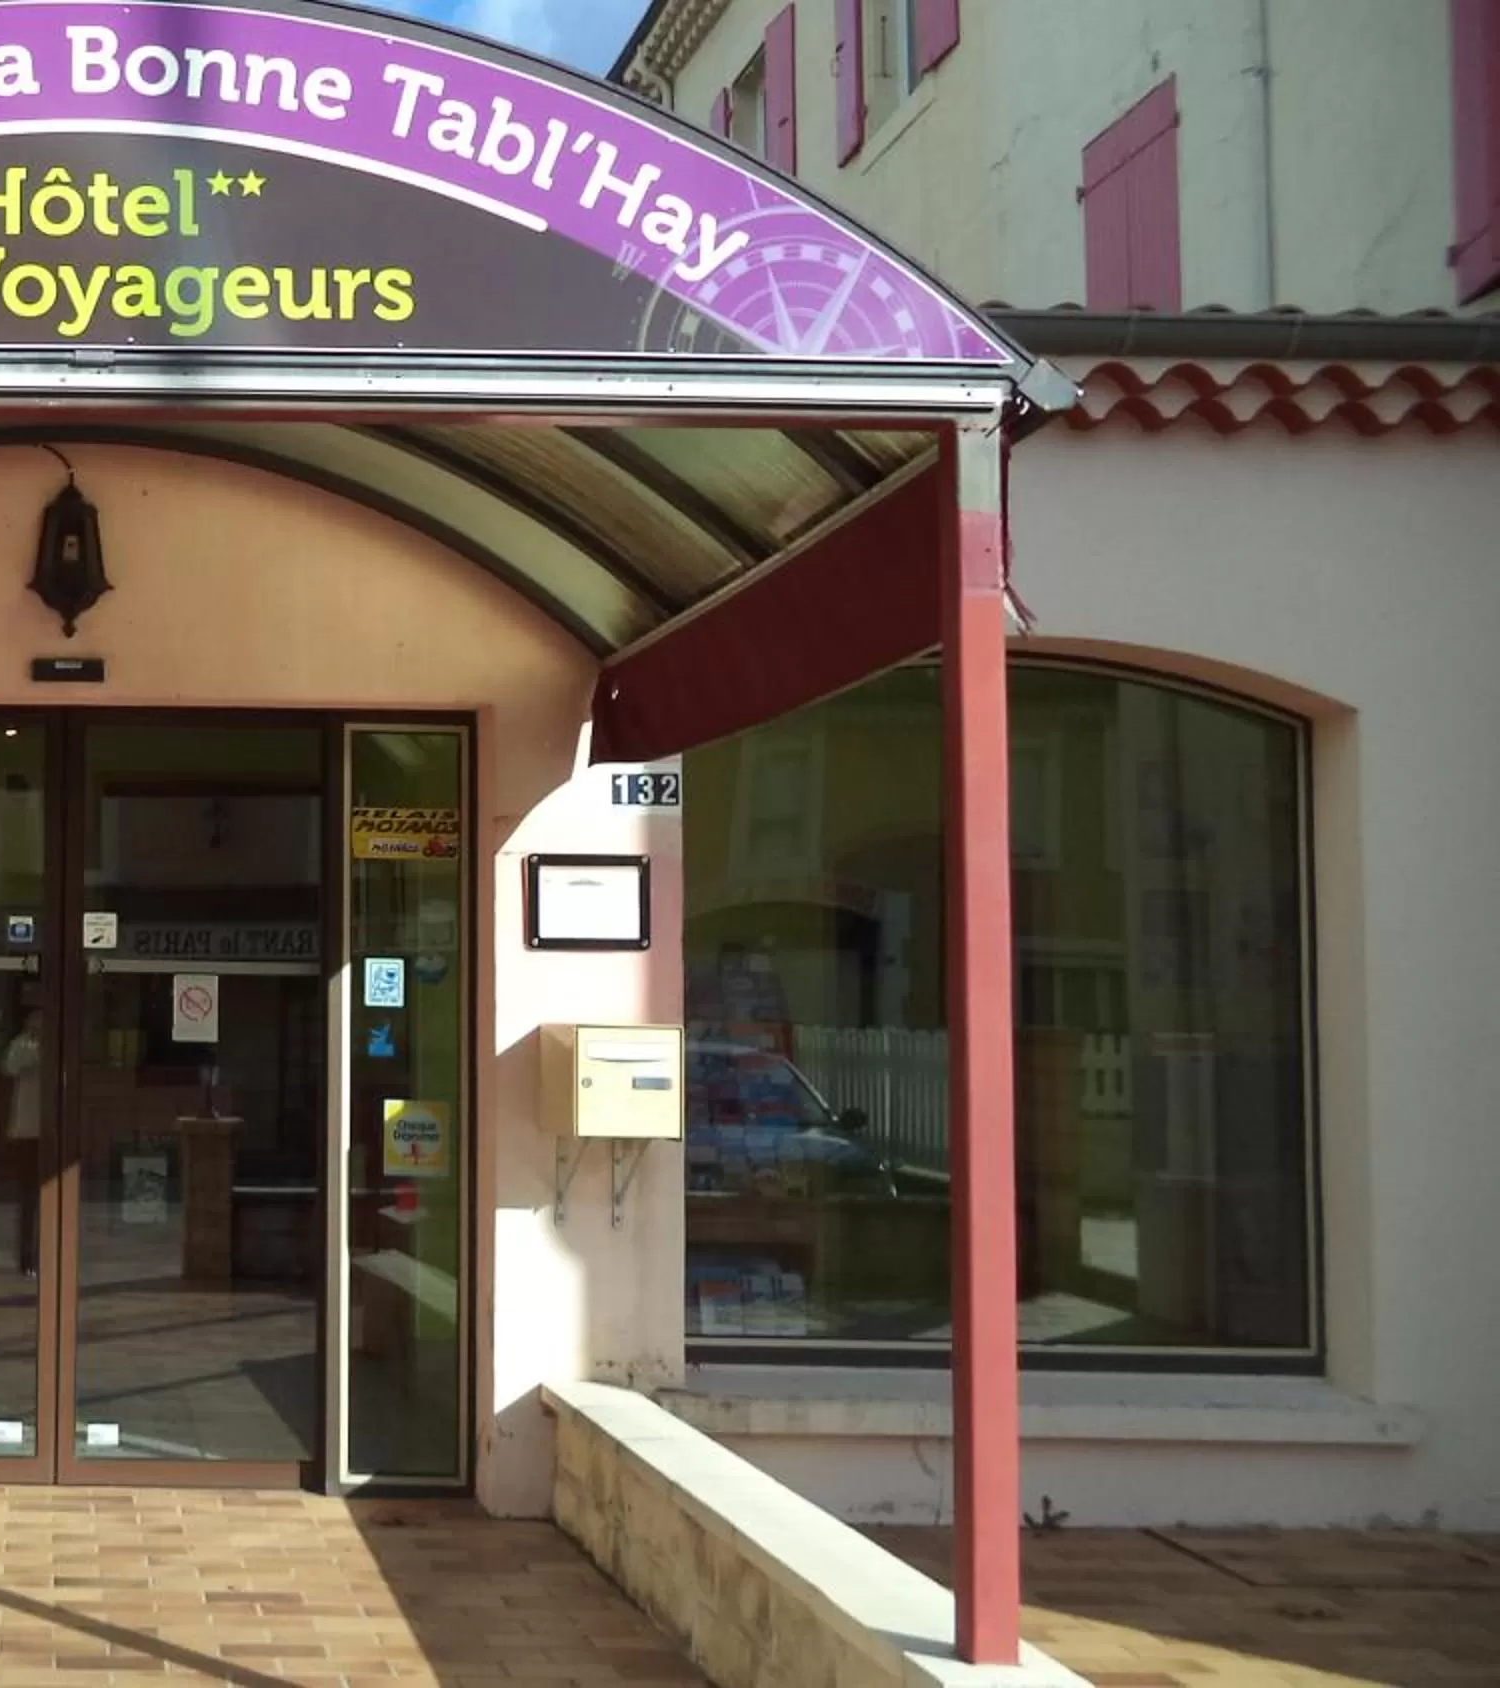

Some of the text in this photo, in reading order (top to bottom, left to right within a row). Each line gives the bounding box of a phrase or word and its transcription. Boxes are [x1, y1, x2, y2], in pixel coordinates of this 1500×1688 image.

[66, 25, 352, 120] Bonne
[383, 63, 750, 282] Tabl'Hay
[614, 774, 677, 804] 132
[352, 809, 456, 819] RELAIS
